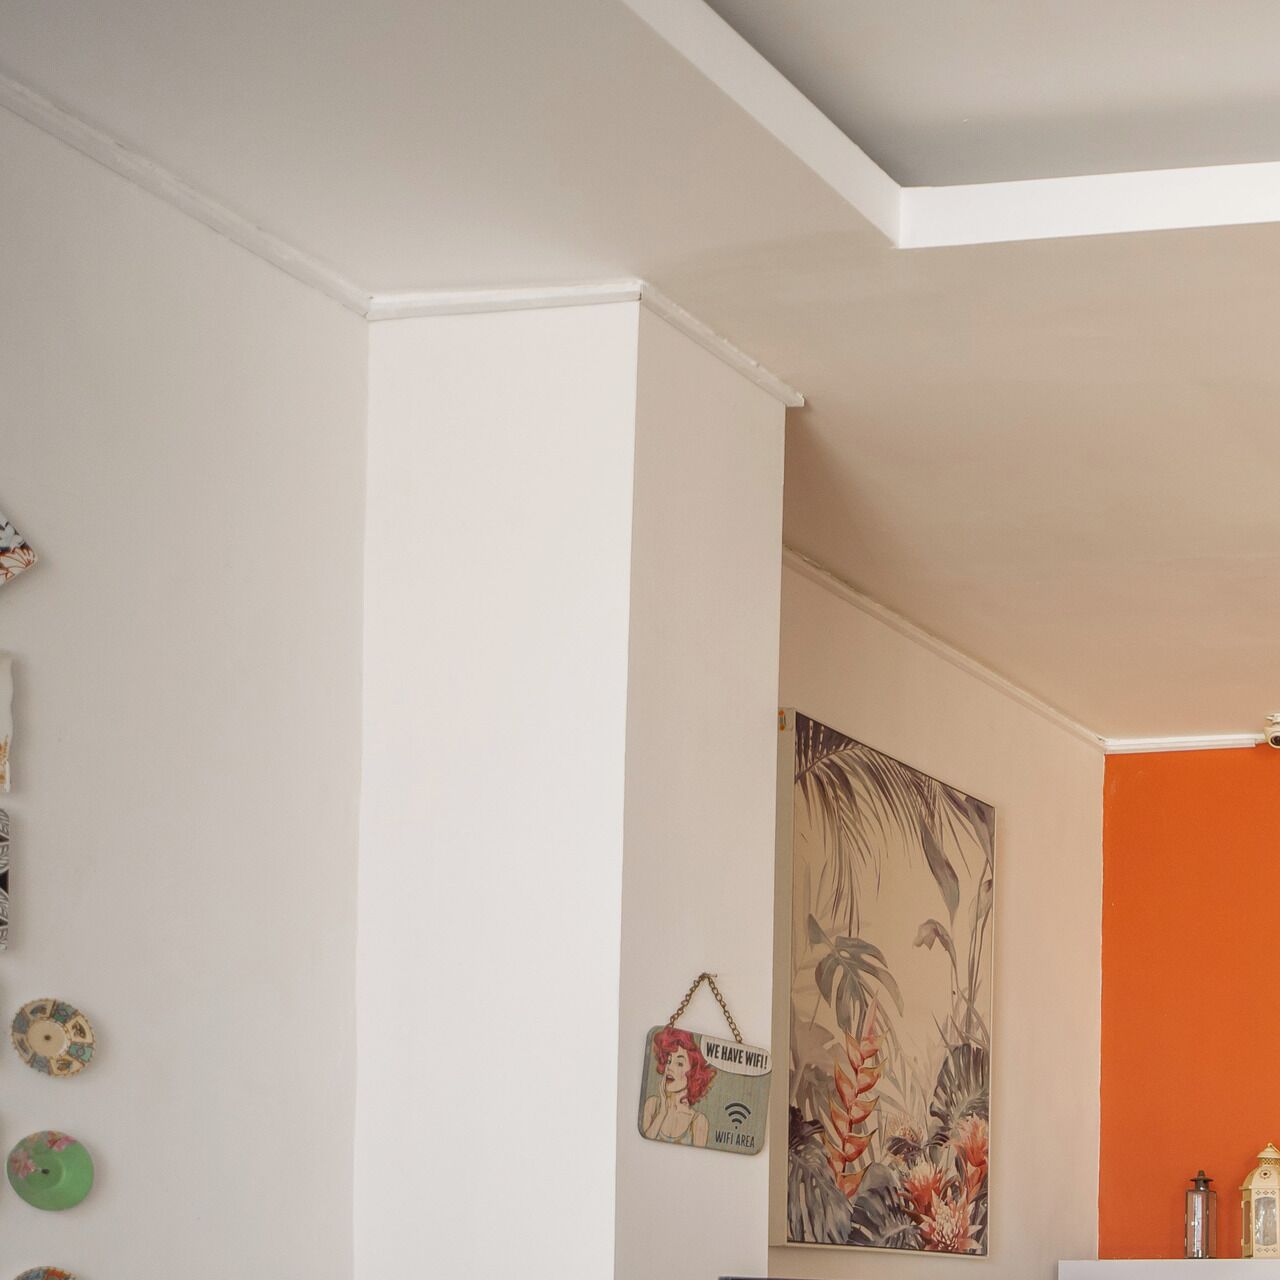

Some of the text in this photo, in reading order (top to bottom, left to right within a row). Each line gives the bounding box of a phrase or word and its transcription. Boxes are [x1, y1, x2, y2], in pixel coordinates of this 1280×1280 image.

[706, 1042, 768, 1070] WE HAVE WIFI!
[715, 1130, 755, 1149] WIFI AREA
